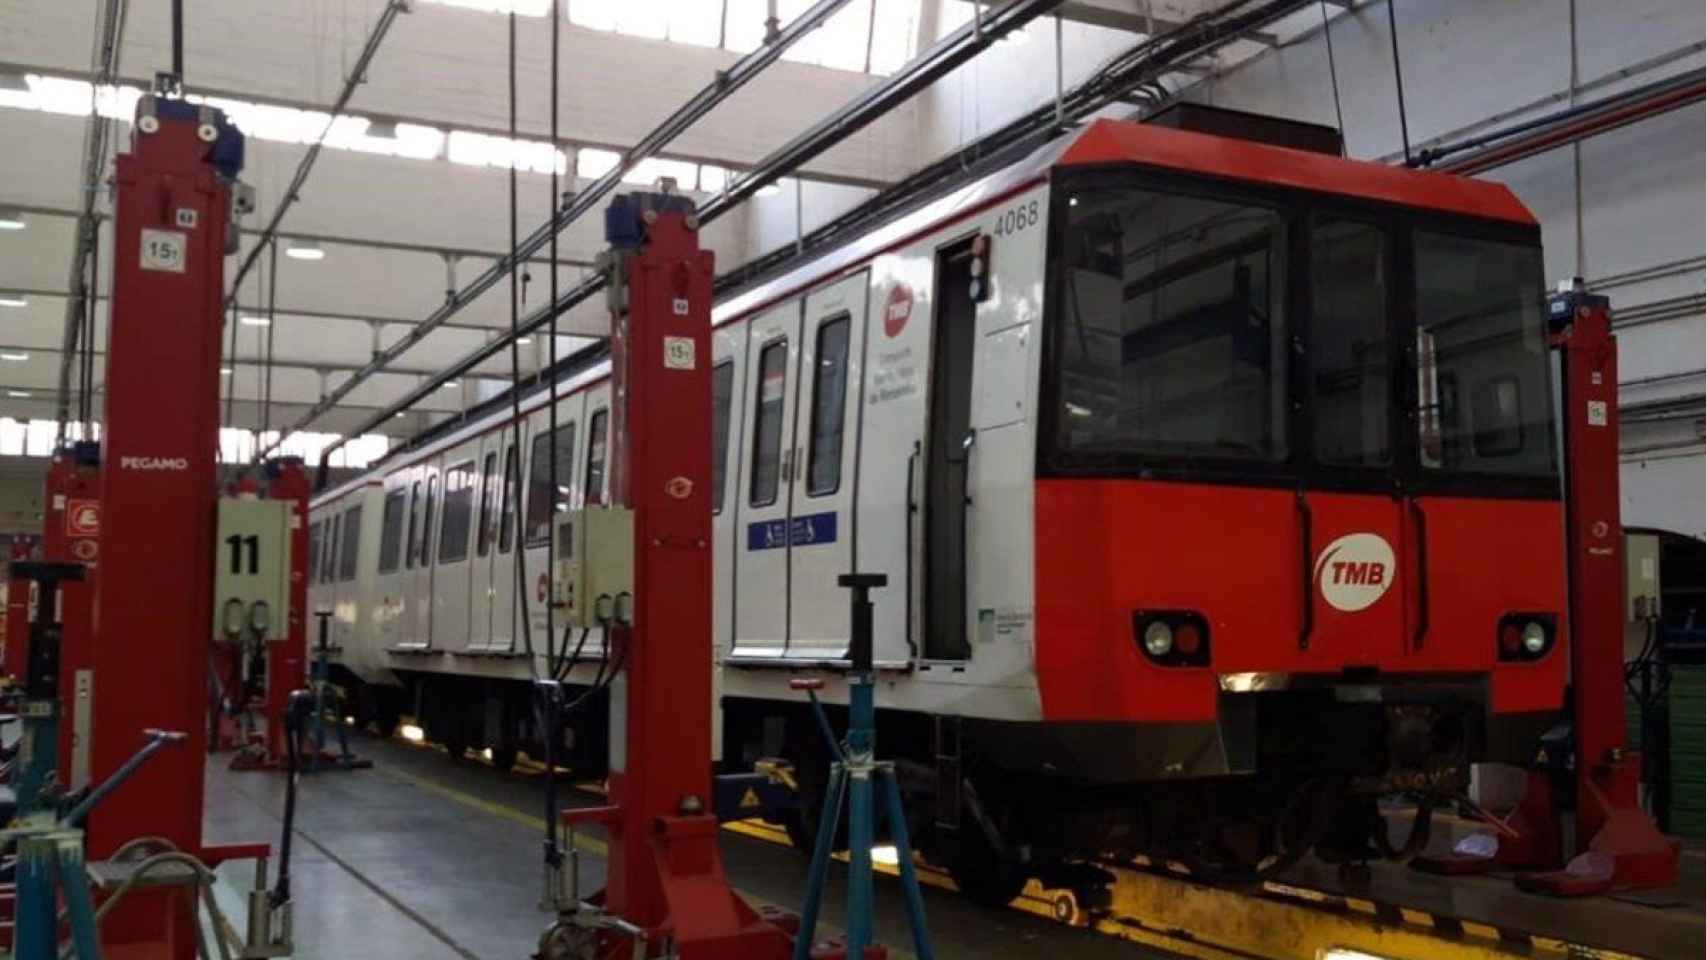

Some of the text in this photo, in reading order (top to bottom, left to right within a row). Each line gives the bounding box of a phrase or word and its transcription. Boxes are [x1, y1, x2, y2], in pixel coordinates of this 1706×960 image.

[993, 200, 1039, 238] 4068
[120, 456, 188, 470] PEGAMO
[225, 534, 260, 575] 11
[1331, 562, 1386, 585] TMB
